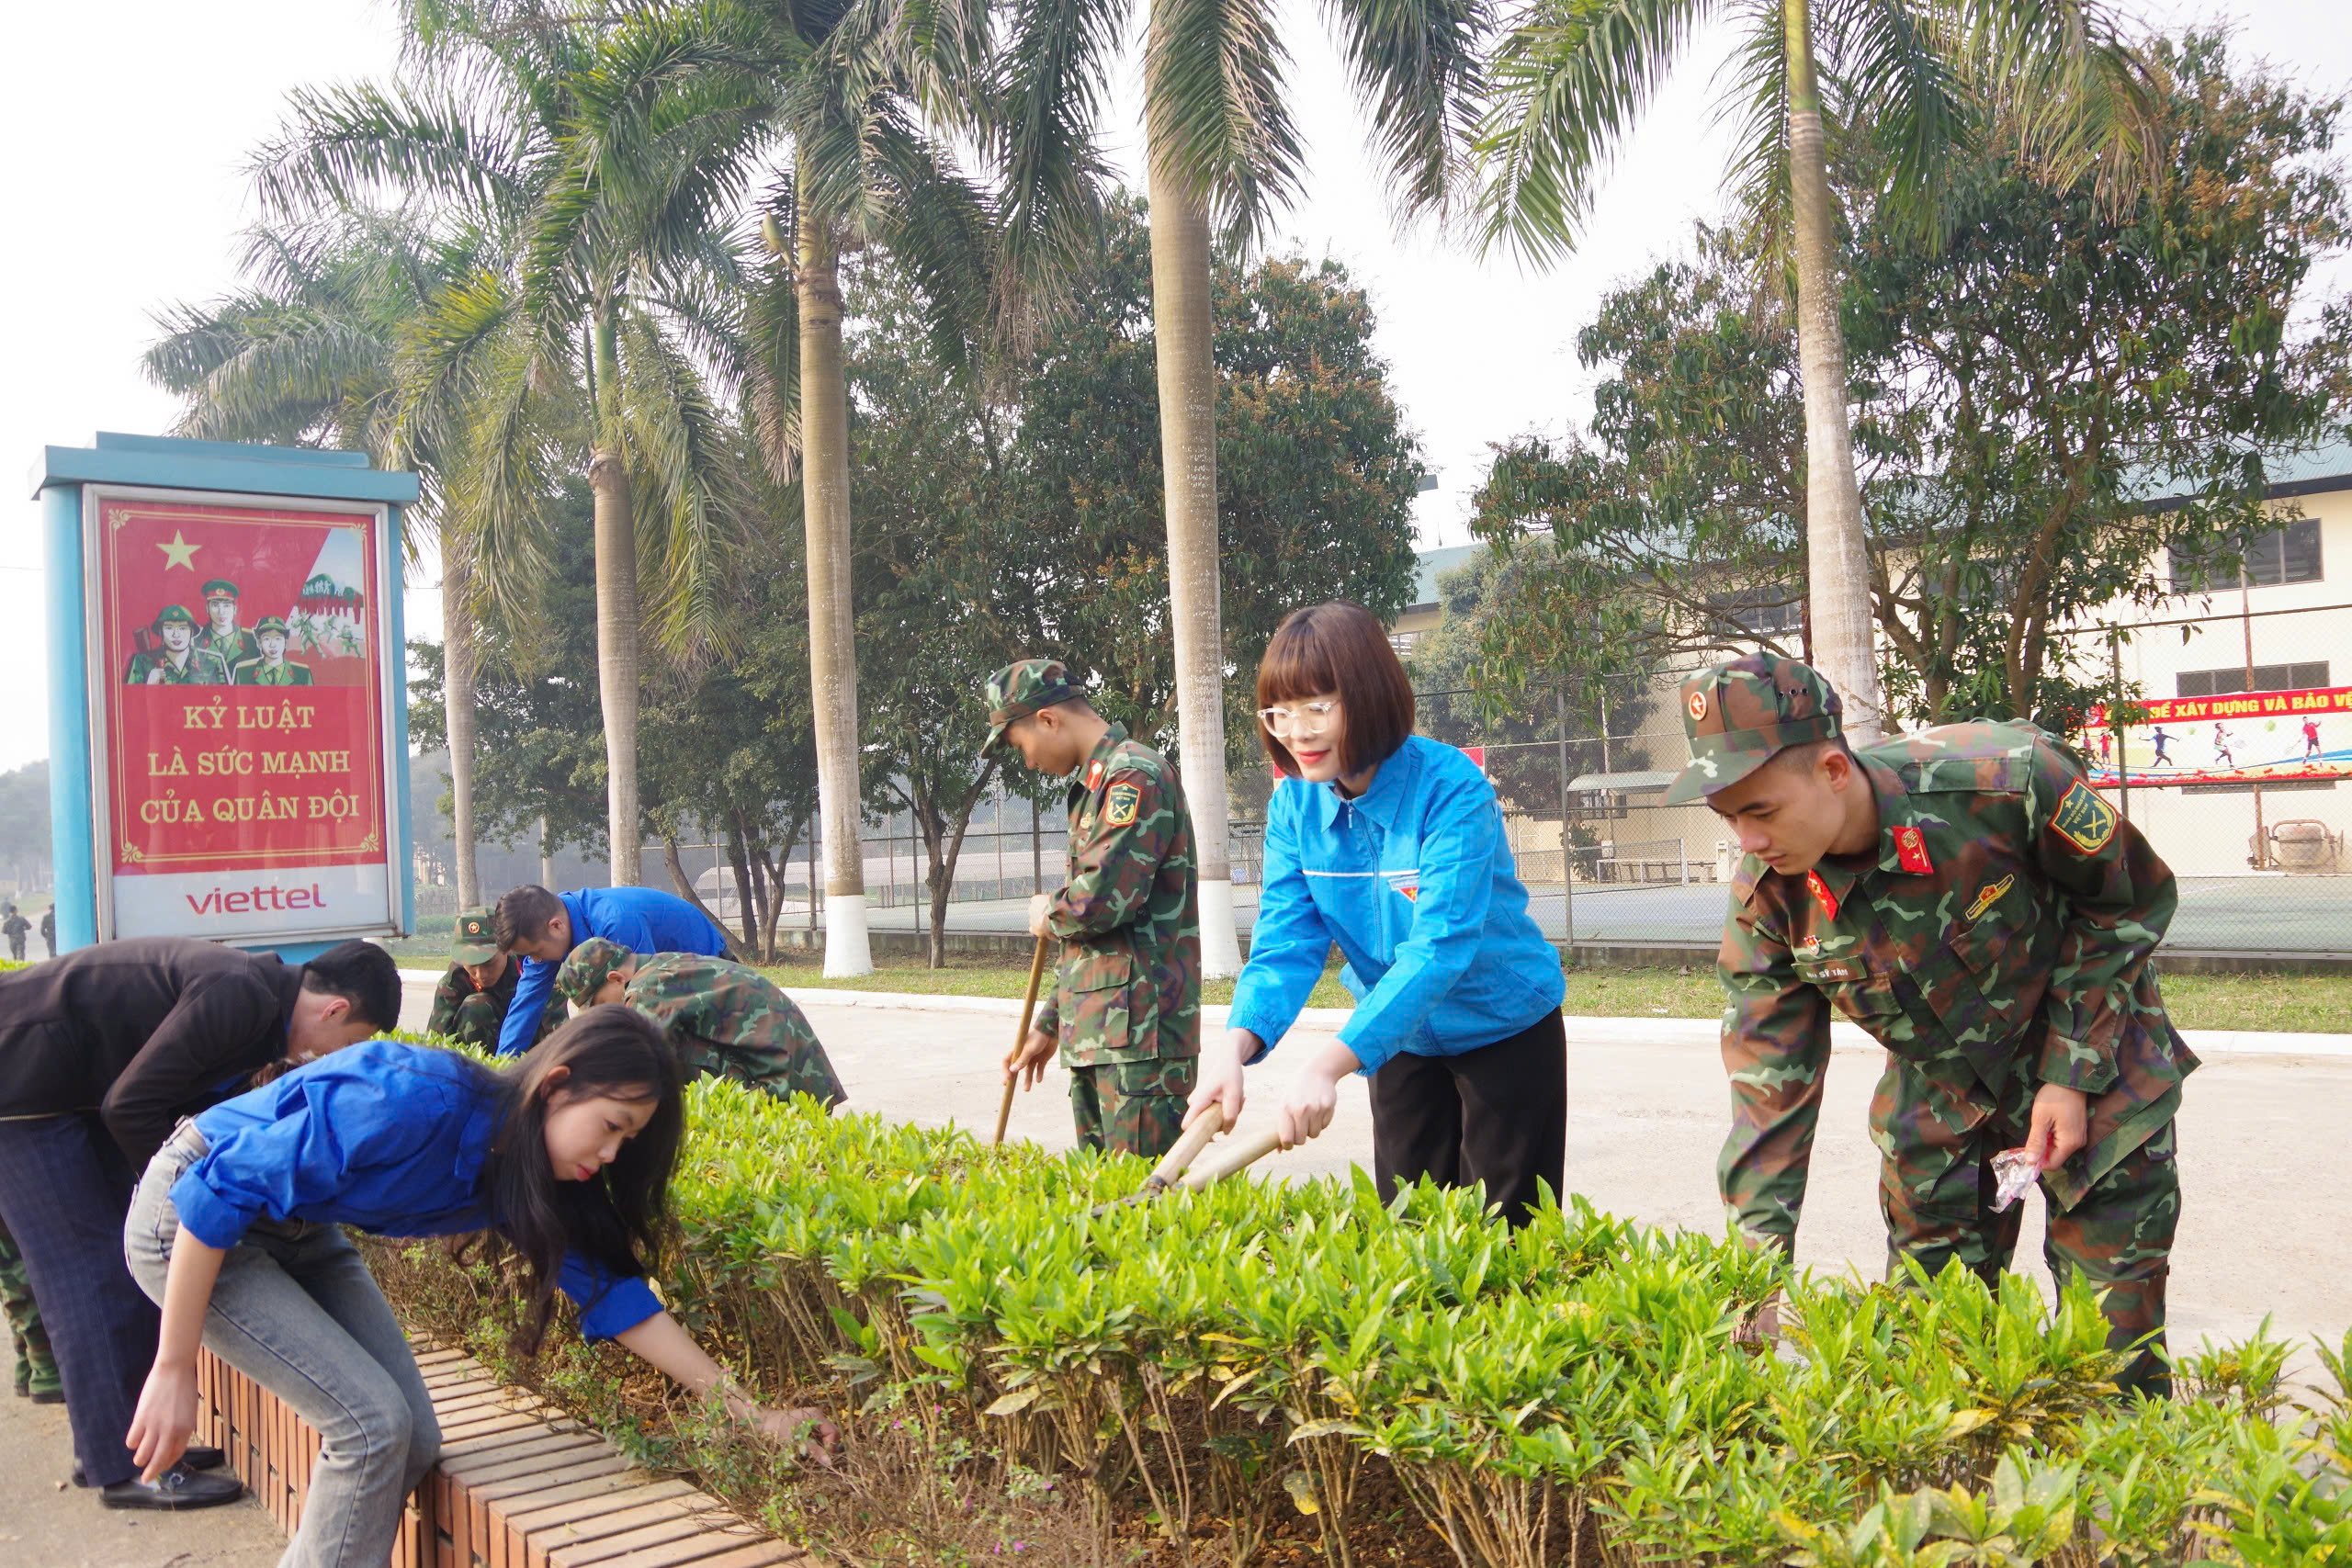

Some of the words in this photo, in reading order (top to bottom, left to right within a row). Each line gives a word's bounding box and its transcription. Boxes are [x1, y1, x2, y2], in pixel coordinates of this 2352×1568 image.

[184, 695, 228, 728] KỶ
[237, 698, 314, 734] LUẬT
[2176, 701, 2208, 716] XÂY
[2212, 699, 2259, 716] DỰNG
[2264, 696, 2288, 712] VÀ
[2292, 693, 2329, 709] BẢO
[148, 746, 189, 776] LÀ
[198, 745, 253, 775] SỨC
[261, 750, 350, 779] MẠNH
[141, 789, 204, 823] CỦA
[212, 789, 299, 822] QUÂN
[308, 788, 359, 823] ĐỘI
[186, 883, 326, 915] viettel
